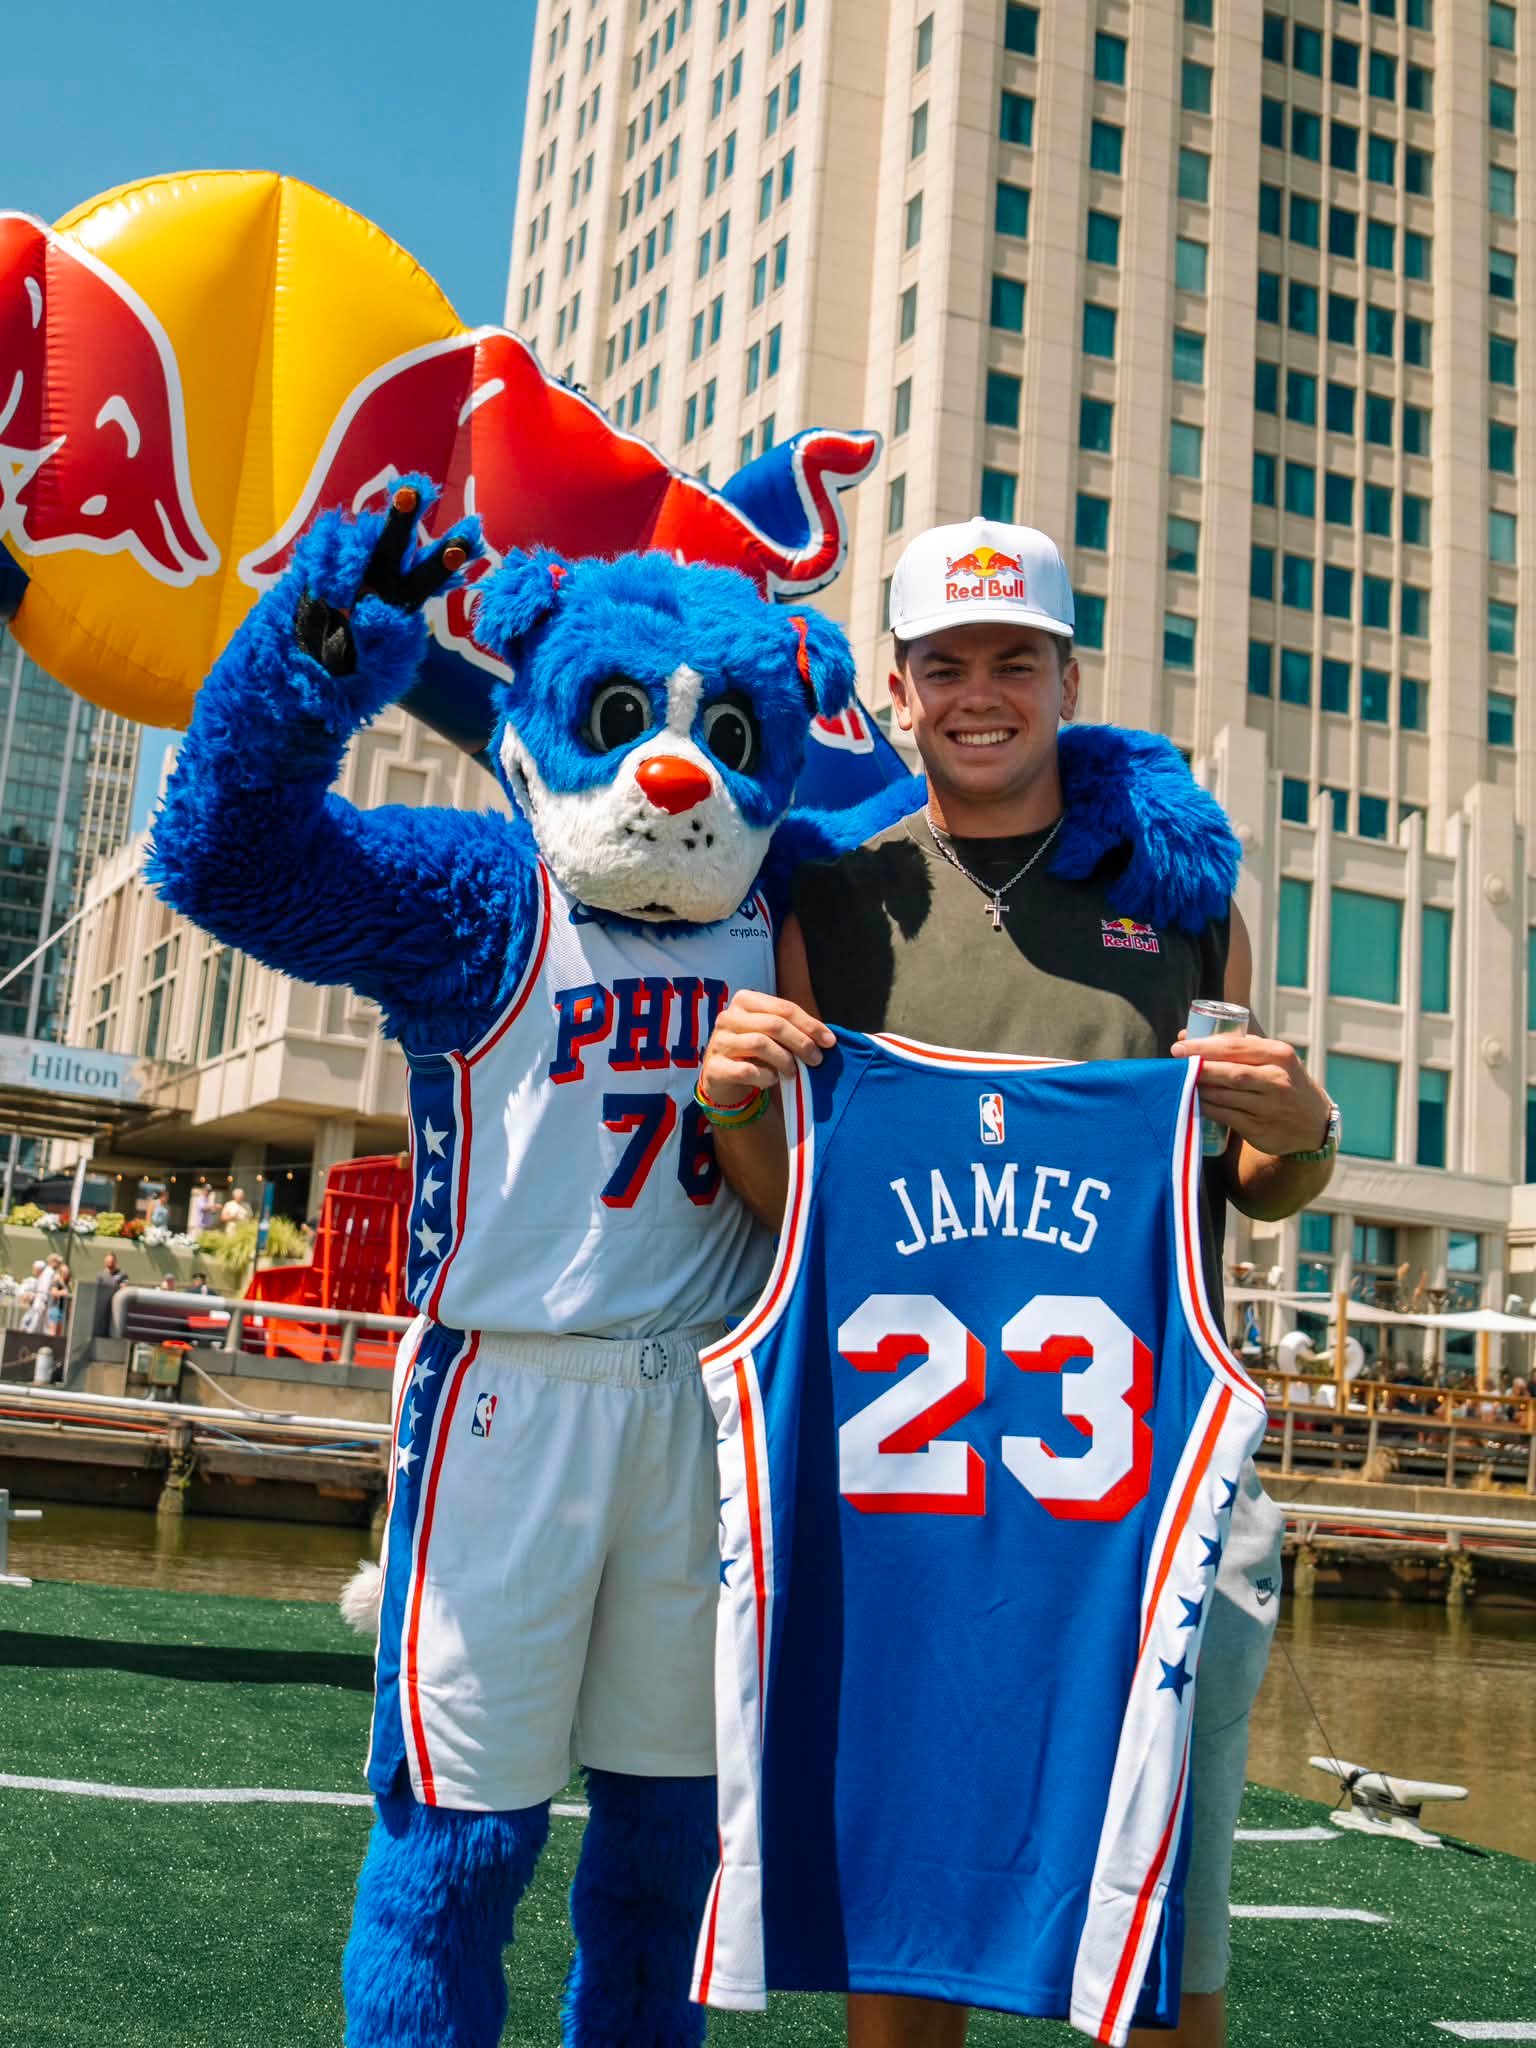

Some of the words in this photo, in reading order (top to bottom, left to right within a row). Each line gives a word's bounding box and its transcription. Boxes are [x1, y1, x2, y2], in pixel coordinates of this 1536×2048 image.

[945, 579, 985, 601] Red
[988, 579, 1024, 599] Bull
[1102, 933, 1133, 949] Red
[1133, 936, 1159, 952] Bull
[31, 1053, 119, 1088] Hilton
[600, 1093, 722, 1209] 76
[889, 1163, 1111, 1256] JAMES
[837, 1294, 1154, 1523] 23
